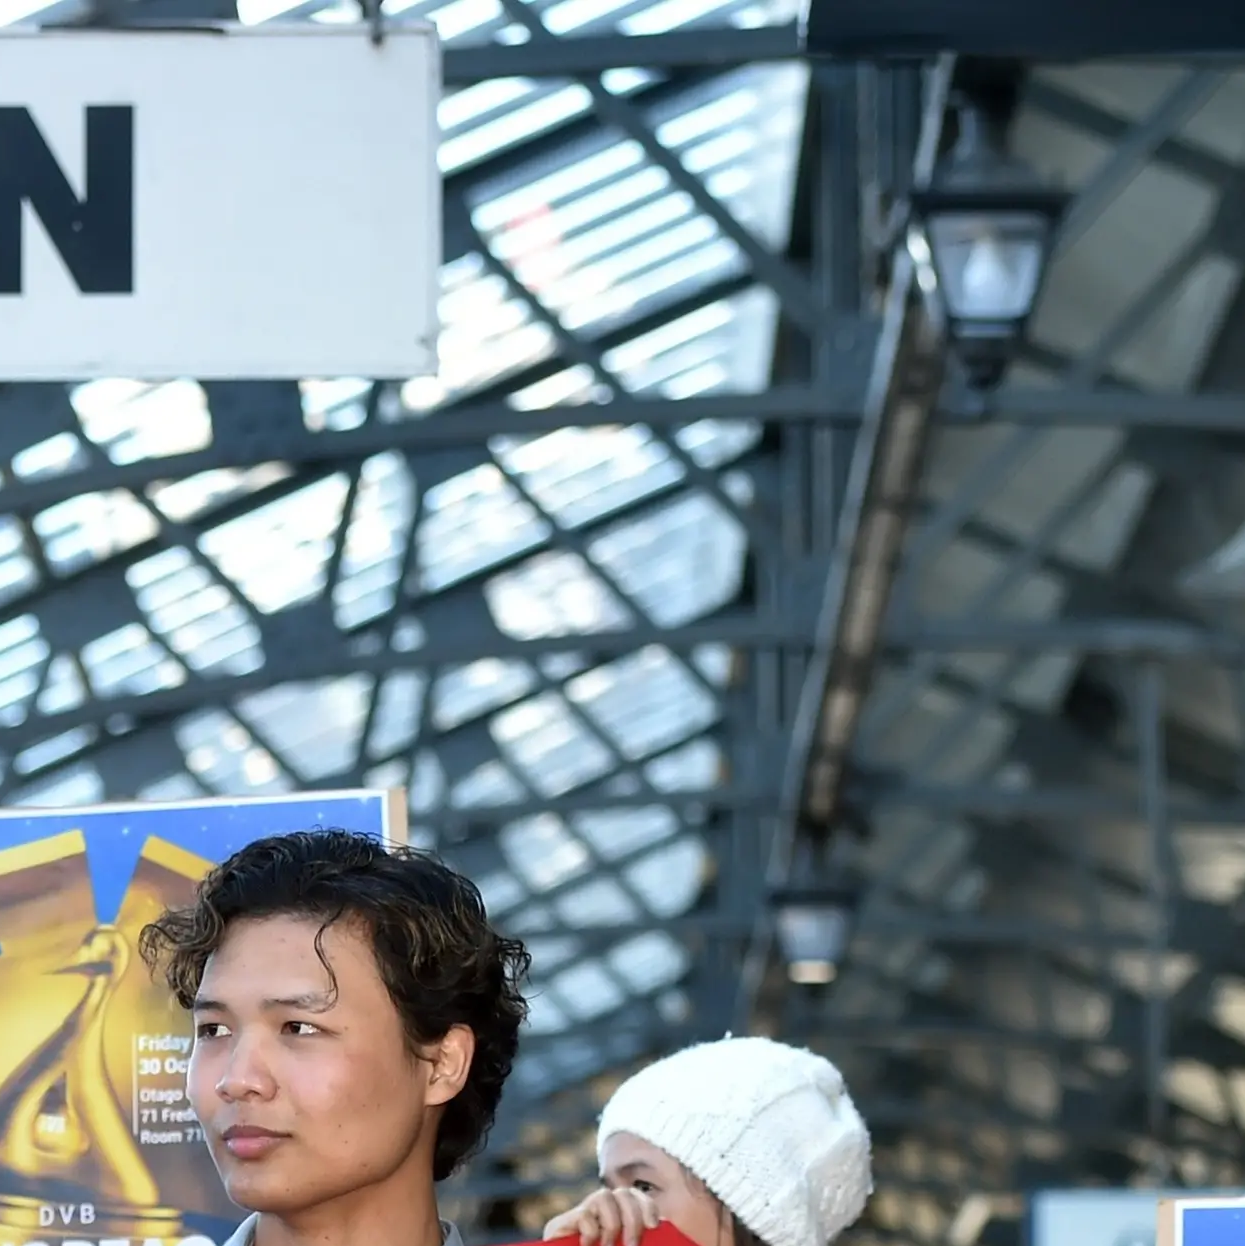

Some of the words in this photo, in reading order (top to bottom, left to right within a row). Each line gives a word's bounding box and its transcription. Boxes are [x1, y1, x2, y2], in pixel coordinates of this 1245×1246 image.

[138, 1034, 191, 1053] Friday
[138, 1057, 162, 1075] 30
[164, 1057, 191, 1074] Oc
[139, 1088, 184, 1105] Otago
[141, 1109, 158, 1124] 71
[139, 1130, 183, 1144] Room
[38, 1202, 96, 1227] DVB
